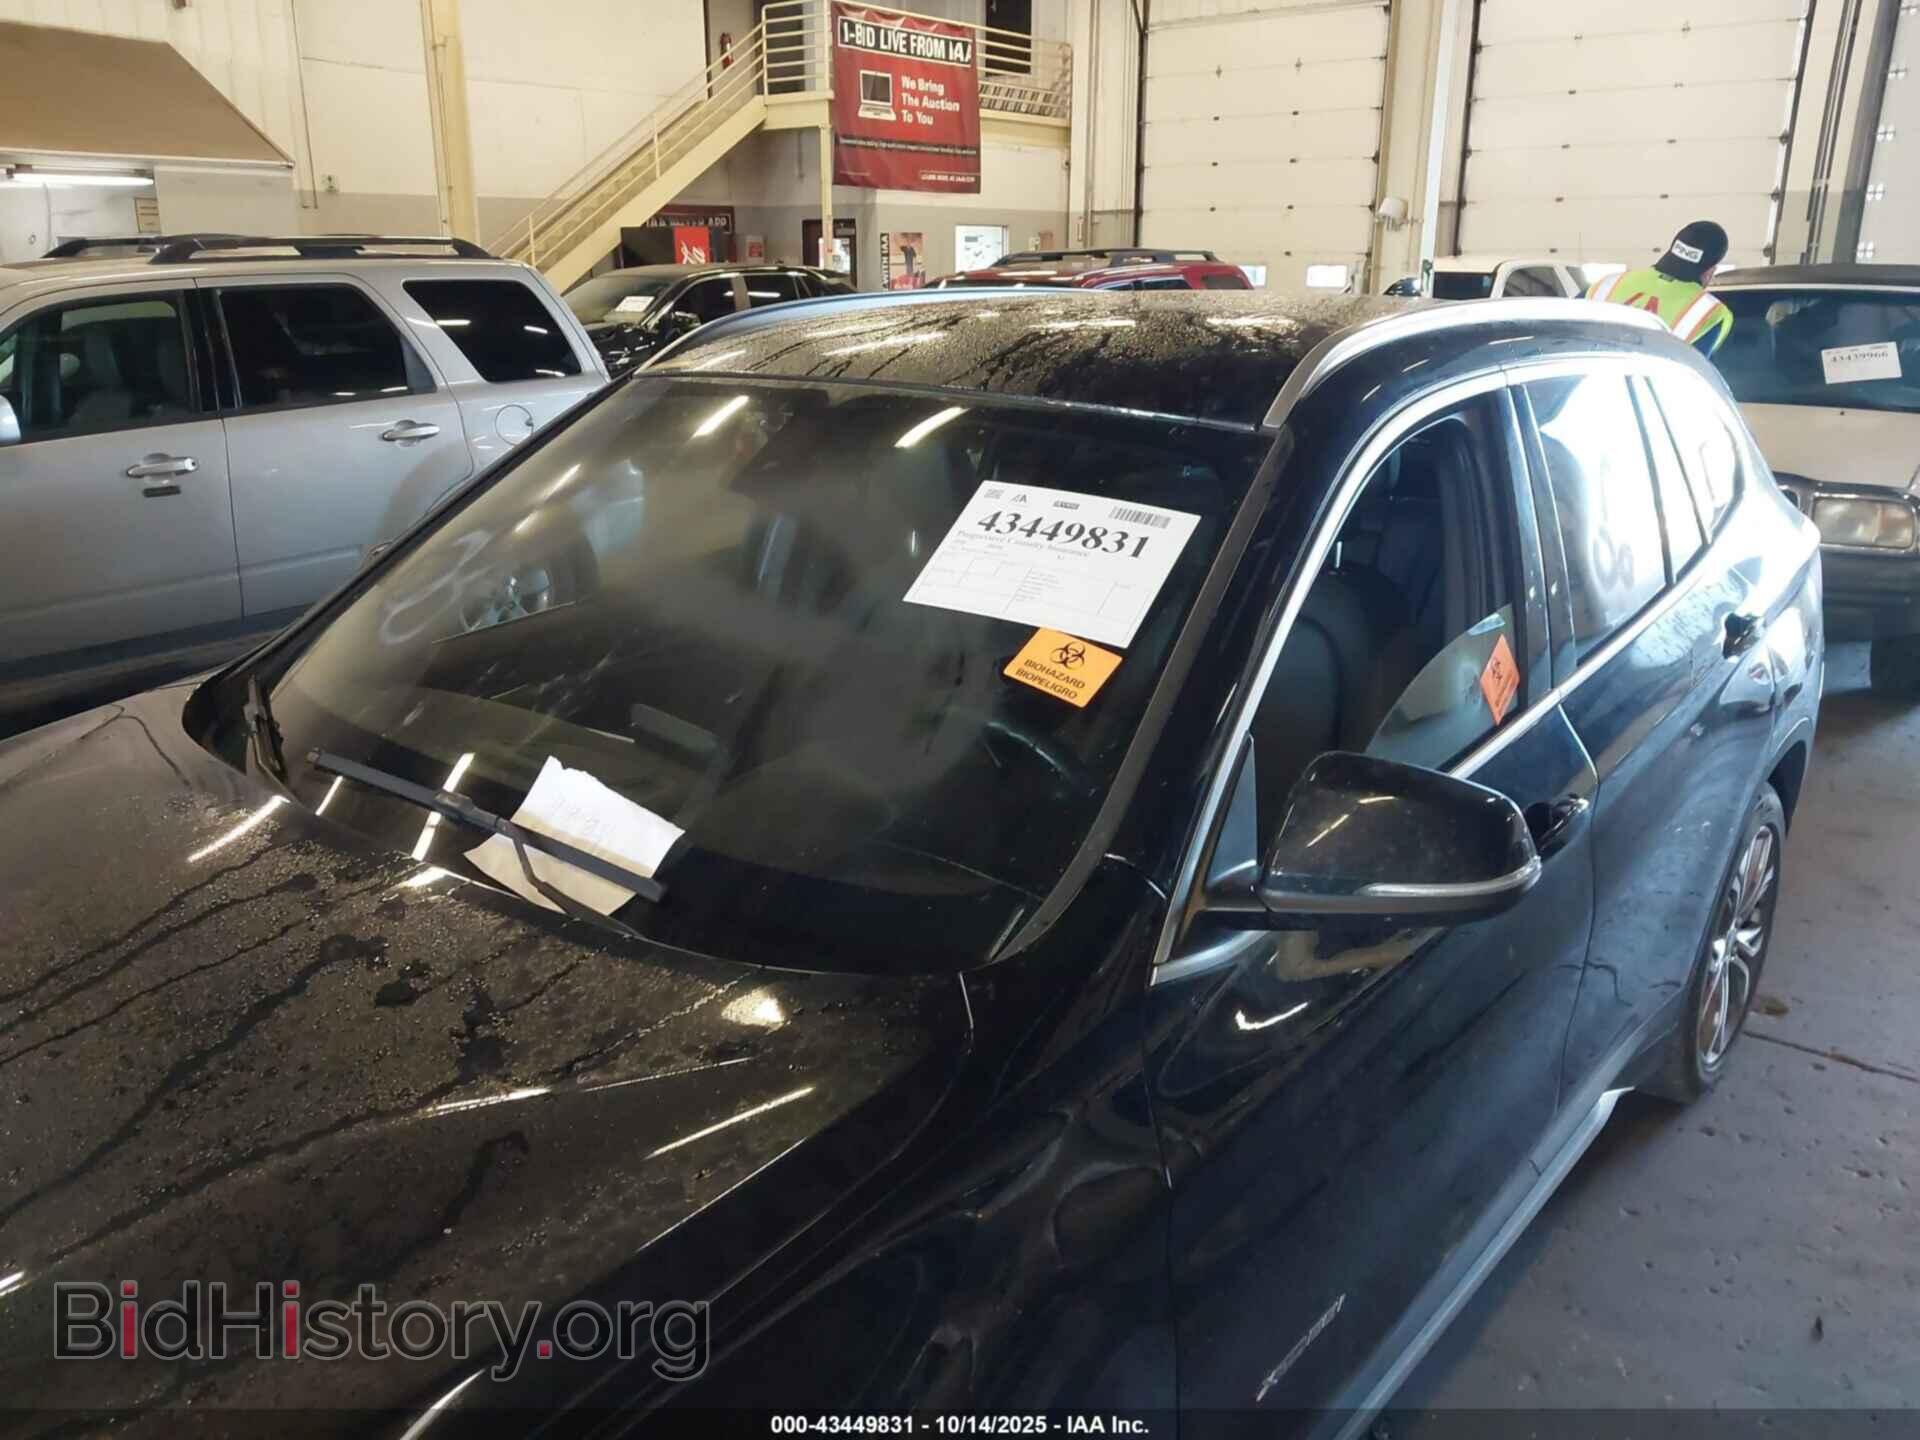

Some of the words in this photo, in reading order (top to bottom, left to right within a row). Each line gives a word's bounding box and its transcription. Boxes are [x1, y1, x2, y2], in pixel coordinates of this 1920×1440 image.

[843, 21, 876, 48] I-BID
[880, 28, 908, 53] LIVE
[910, 33, 945, 60] FROM
[901, 75, 916, 89] We
[918, 78, 944, 96] Bring
[901, 92, 919, 107] The
[922, 96, 960, 112] Auction
[901, 109, 913, 124] To
[916, 111, 934, 125] You
[978, 510, 1150, 559] 43449831
[1016, 668, 1078, 699] BIOPELIGRO
[1024, 659, 1086, 689] BIOHAZARD
